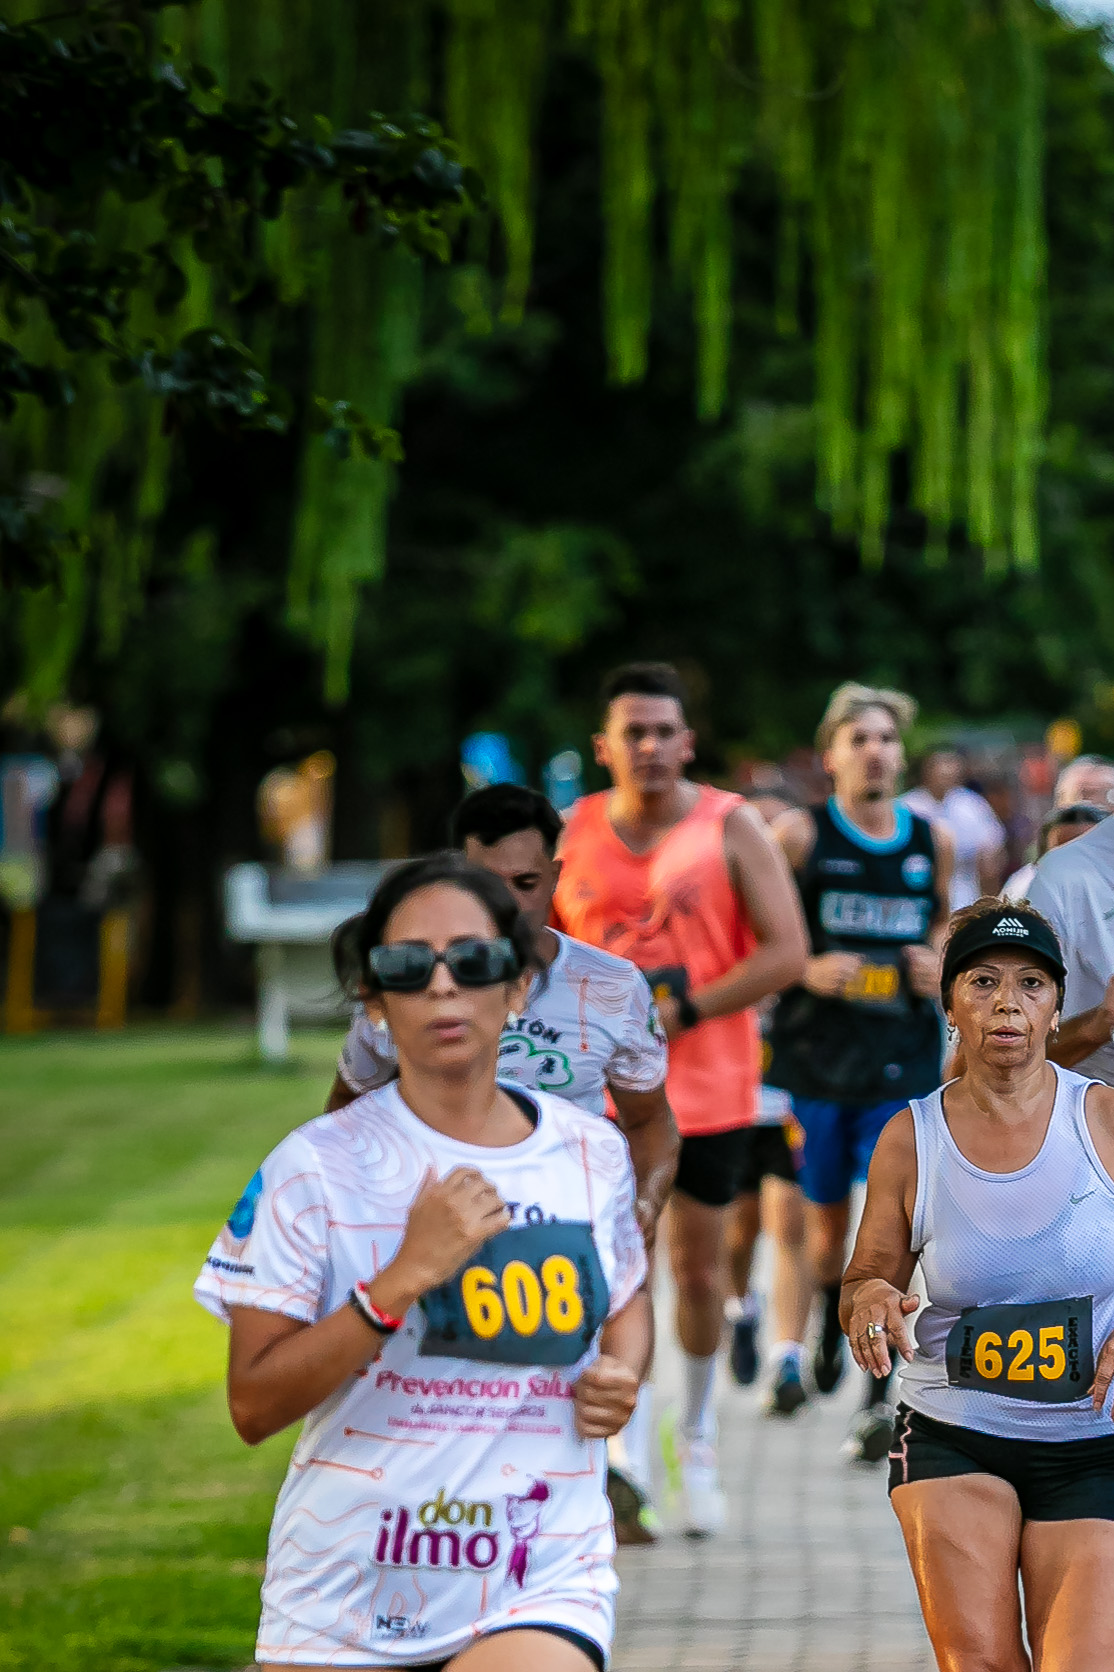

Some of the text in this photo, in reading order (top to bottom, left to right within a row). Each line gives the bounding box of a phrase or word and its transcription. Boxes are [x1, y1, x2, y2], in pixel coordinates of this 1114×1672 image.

[461, 1254, 585, 1342] 608
[974, 1325, 1066, 1381] 625
[1067, 1316, 1081, 1383] EXACTO
[527, 1370, 578, 1399] Salu
[418, 1486, 493, 1527] don
[375, 1506, 500, 1569] ilmo
